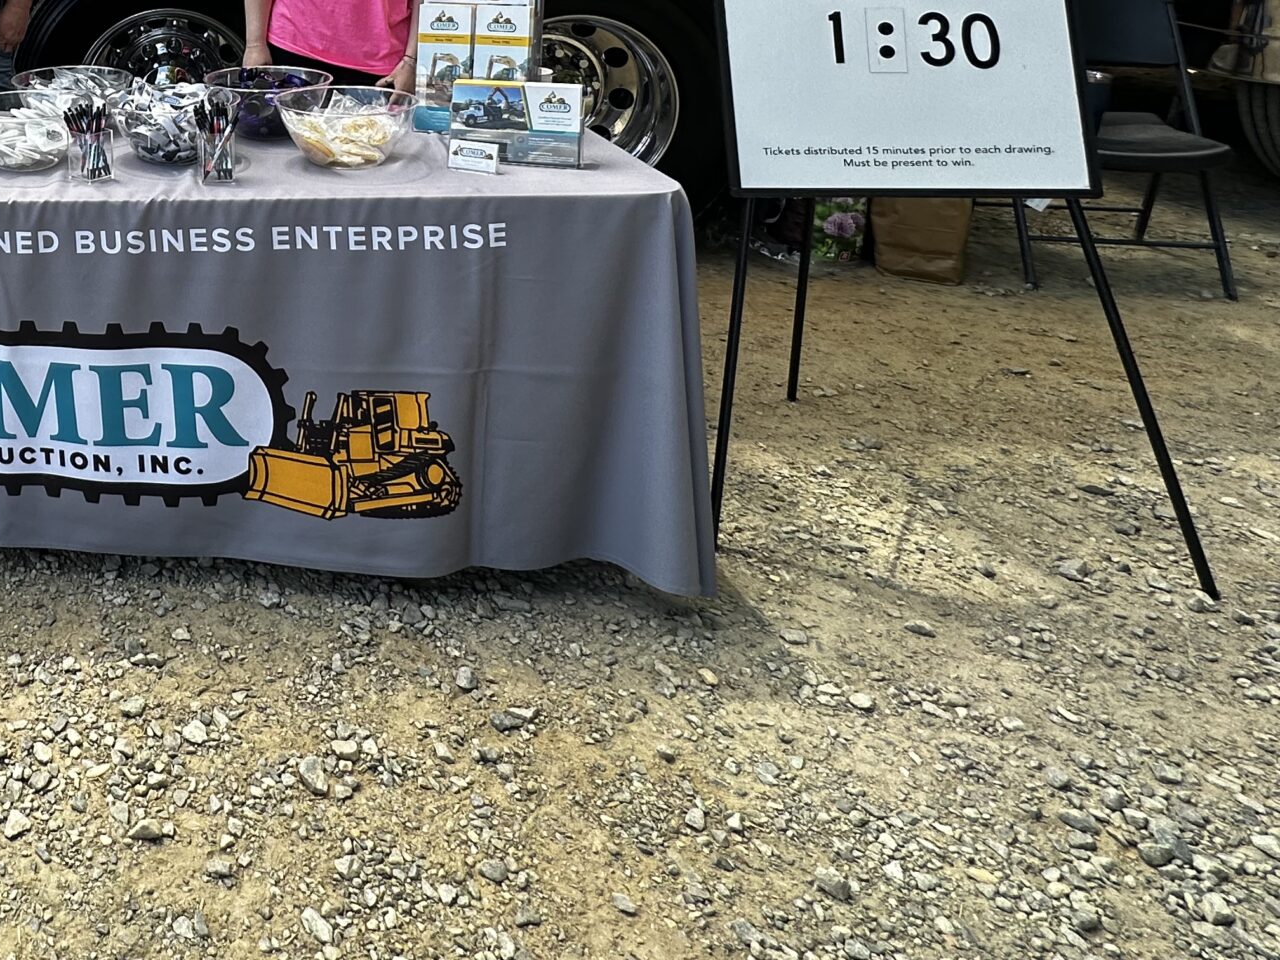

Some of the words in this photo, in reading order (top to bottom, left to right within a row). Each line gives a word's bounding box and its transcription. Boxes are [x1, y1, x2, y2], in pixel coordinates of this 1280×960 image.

[763, 146, 801, 156] Tickets
[803, 146, 863, 156] distributed
[865, 146, 879, 155] 15
[882, 147, 926, 155] minutes
[928, 146, 956, 157] prior
[958, 146, 972, 155] to
[975, 144, 1001, 154] each
[1004, 144, 1055, 156] drawing.
[843, 158, 871, 167] Must
[873, 158, 888, 167] be
[891, 159, 933, 170] present
[935, 159, 949, 167] to
[951, 158, 975, 167] win.
[75, 227, 255, 254] BUSINESS
[272, 222, 507, 251] ENTERPRISE
[139, 453, 204, 476] INC.
